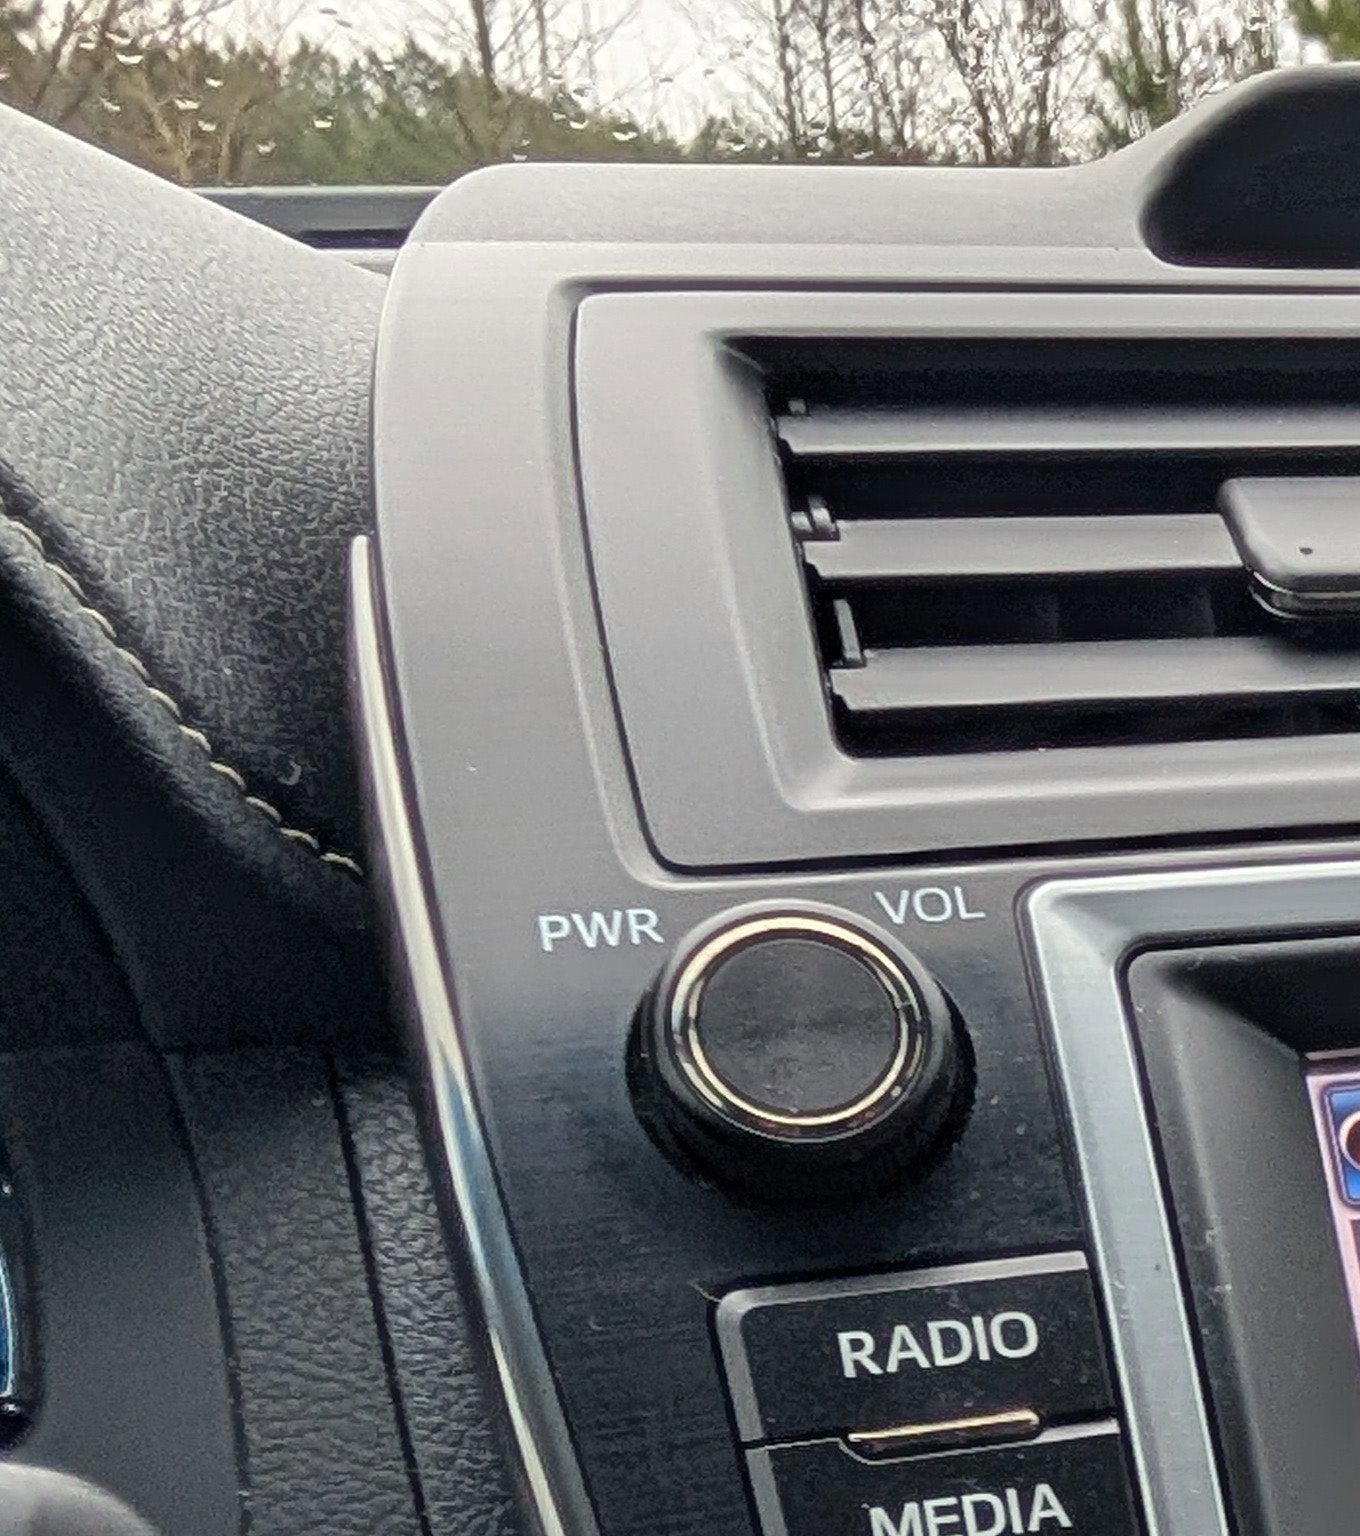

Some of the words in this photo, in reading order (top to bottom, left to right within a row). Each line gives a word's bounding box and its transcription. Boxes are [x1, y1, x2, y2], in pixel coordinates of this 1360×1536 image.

[874, 885, 986, 925] VOL
[538, 908, 665, 952] PWR
[837, 1311, 1039, 1378] RADIO
